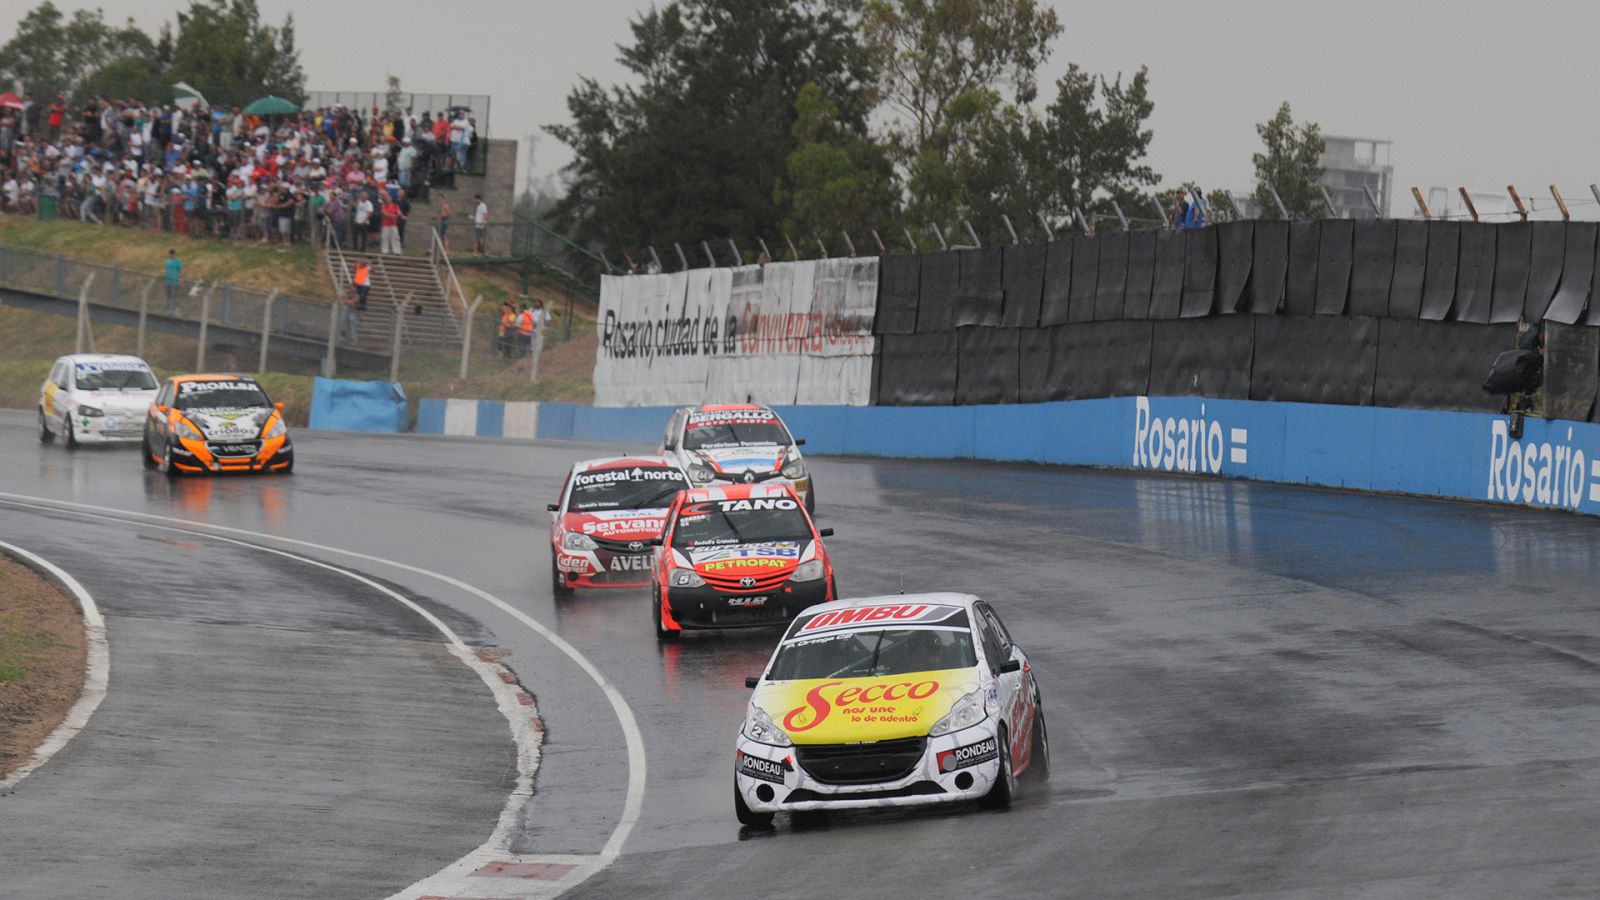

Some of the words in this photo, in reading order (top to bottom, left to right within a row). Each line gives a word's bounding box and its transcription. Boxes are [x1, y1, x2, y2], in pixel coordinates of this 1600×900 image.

[655, 303, 701, 356] ciudad
[703, 304, 719, 356] de
[724, 304, 737, 354] la
[1133, 396, 1223, 474] Rosario
[1487, 420, 1585, 509] Rosario
[575, 469, 630, 486] forestal
[644, 470, 684, 481] norte
[718, 499, 798, 512] TANO
[740, 548, 797, 557] TSB
[704, 559, 787, 572] PETROPAT
[804, 605, 929, 630] OMBU
[783, 680, 940, 733] Secco
[842, 706, 866, 715] nos
[863, 714, 877, 722] de
[879, 714, 918, 722] adentro
[751, 725, 763, 738] 2
[955, 740, 996, 761] RONDEAU
[743, 755, 781, 776] RONDEAU
